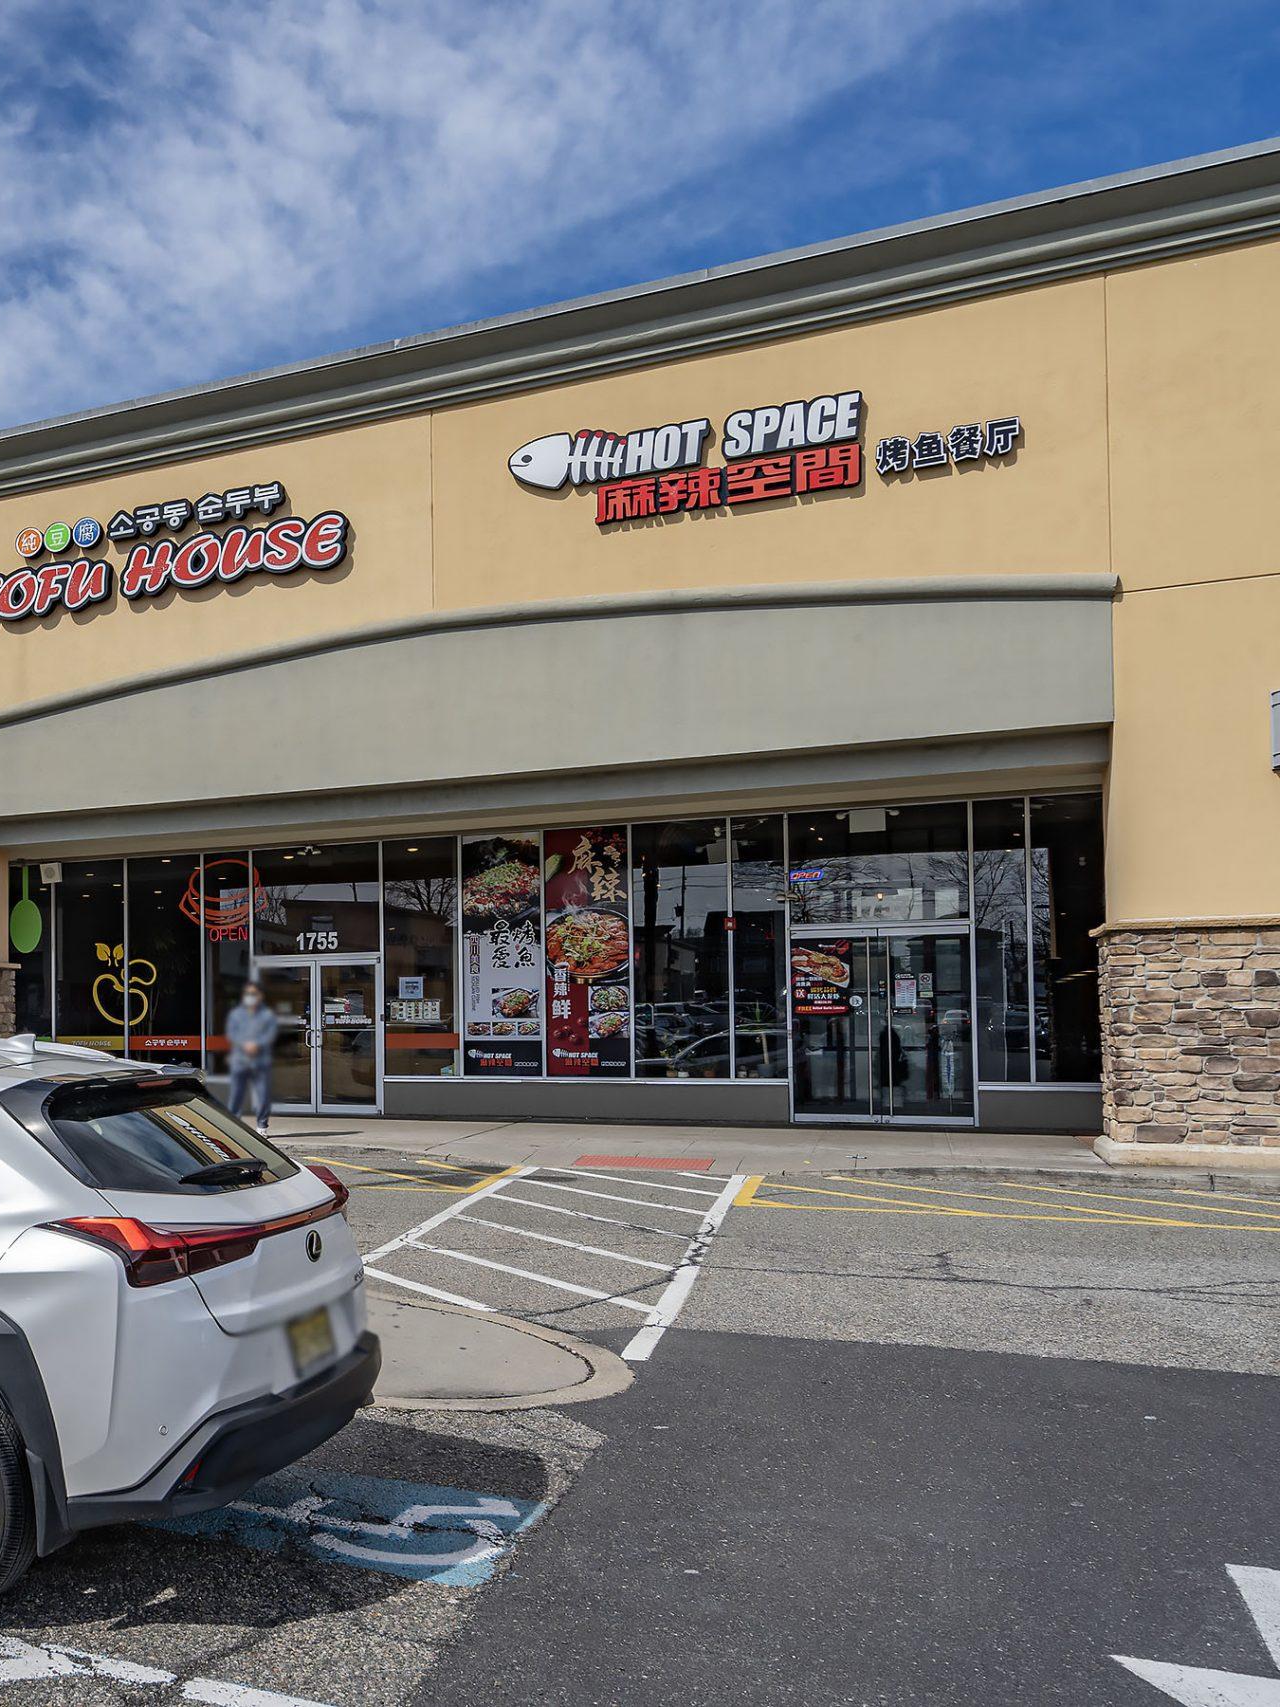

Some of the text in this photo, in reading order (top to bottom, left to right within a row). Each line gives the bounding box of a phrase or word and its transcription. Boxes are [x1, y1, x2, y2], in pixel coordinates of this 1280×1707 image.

[622, 391, 860, 473] HOT SPACE
[875, 416, 1021, 475] 烤鱼餐厅
[108, 482, 282, 538] 소공동 순두부
[595, 442, 860, 525] 麻辣空間
[121, 511, 346, 598] HOUSE
[209, 926, 248, 942] OPEN
[296, 931, 338, 950] 1755
